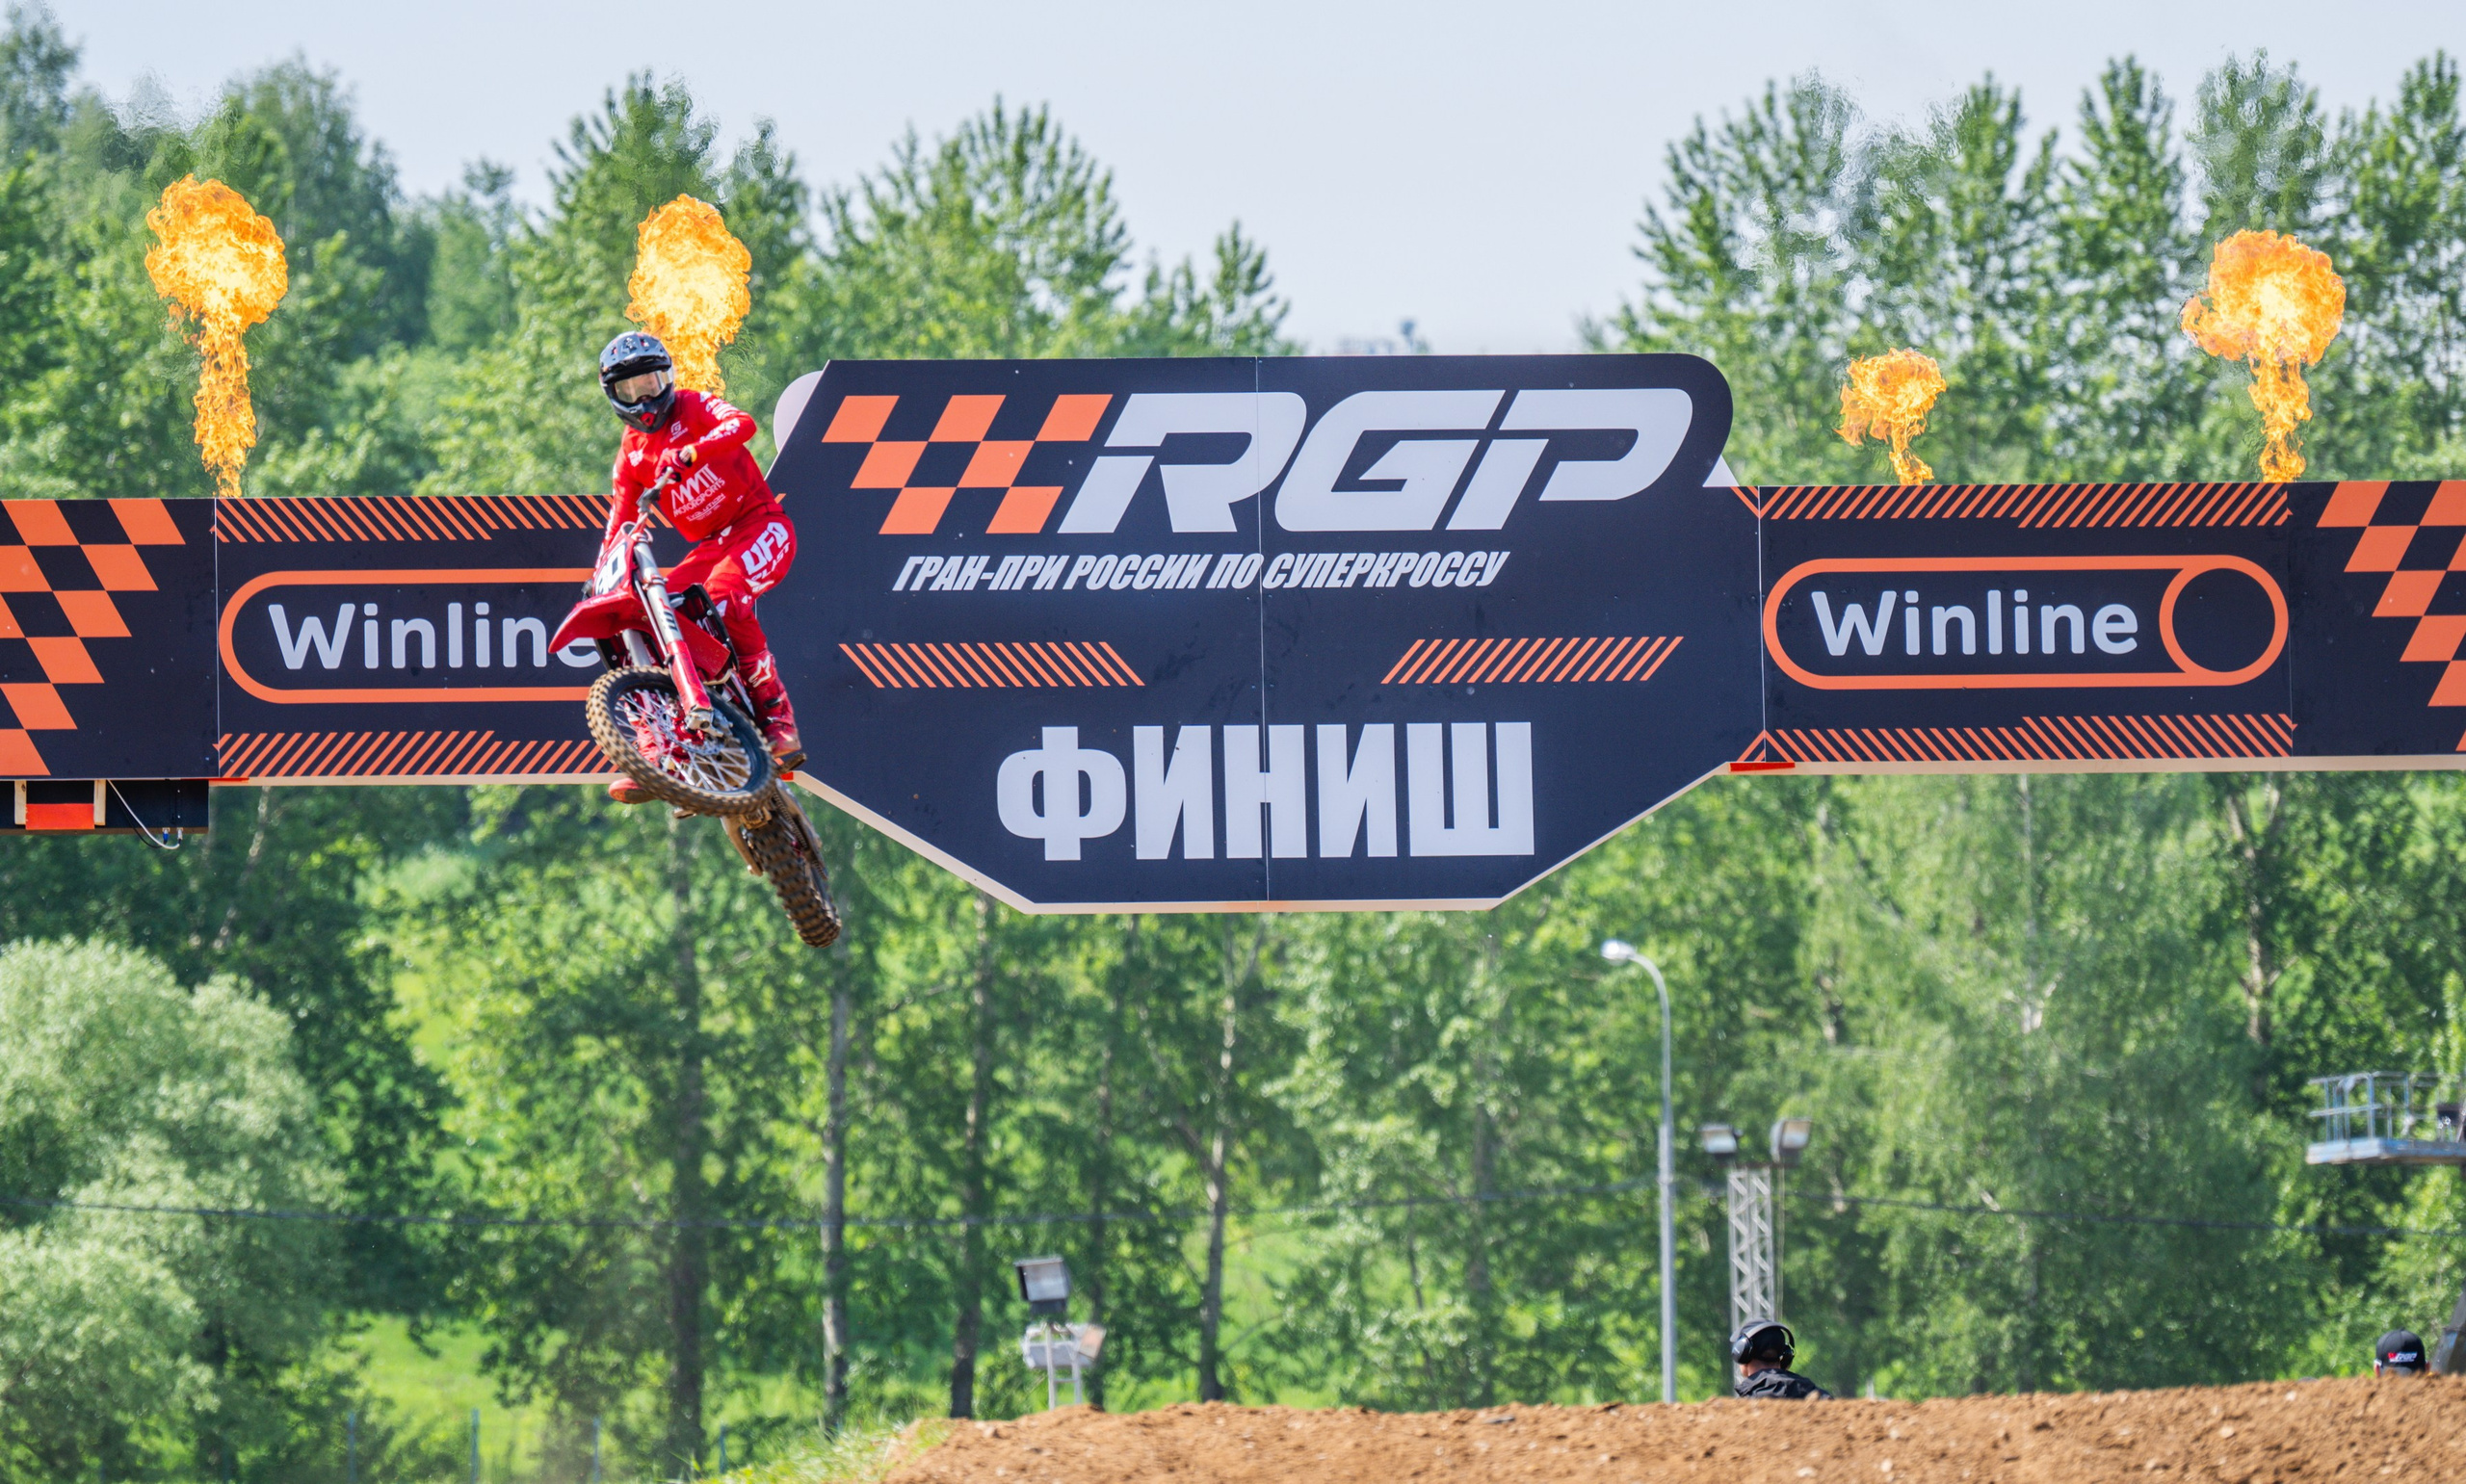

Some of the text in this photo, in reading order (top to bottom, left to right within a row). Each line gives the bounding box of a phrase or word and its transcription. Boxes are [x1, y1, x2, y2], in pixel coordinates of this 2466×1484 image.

[1058, 388, 1693, 534] RGP
[673, 477, 725, 517] MOTORSPORTS
[892, 551, 1511, 591] ГРАН-ПРИ РОССИИ ПО СУПЕРКРОССУ
[1811, 589, 2138, 656] Winline
[996, 721, 1535, 861] ФИНИШ
